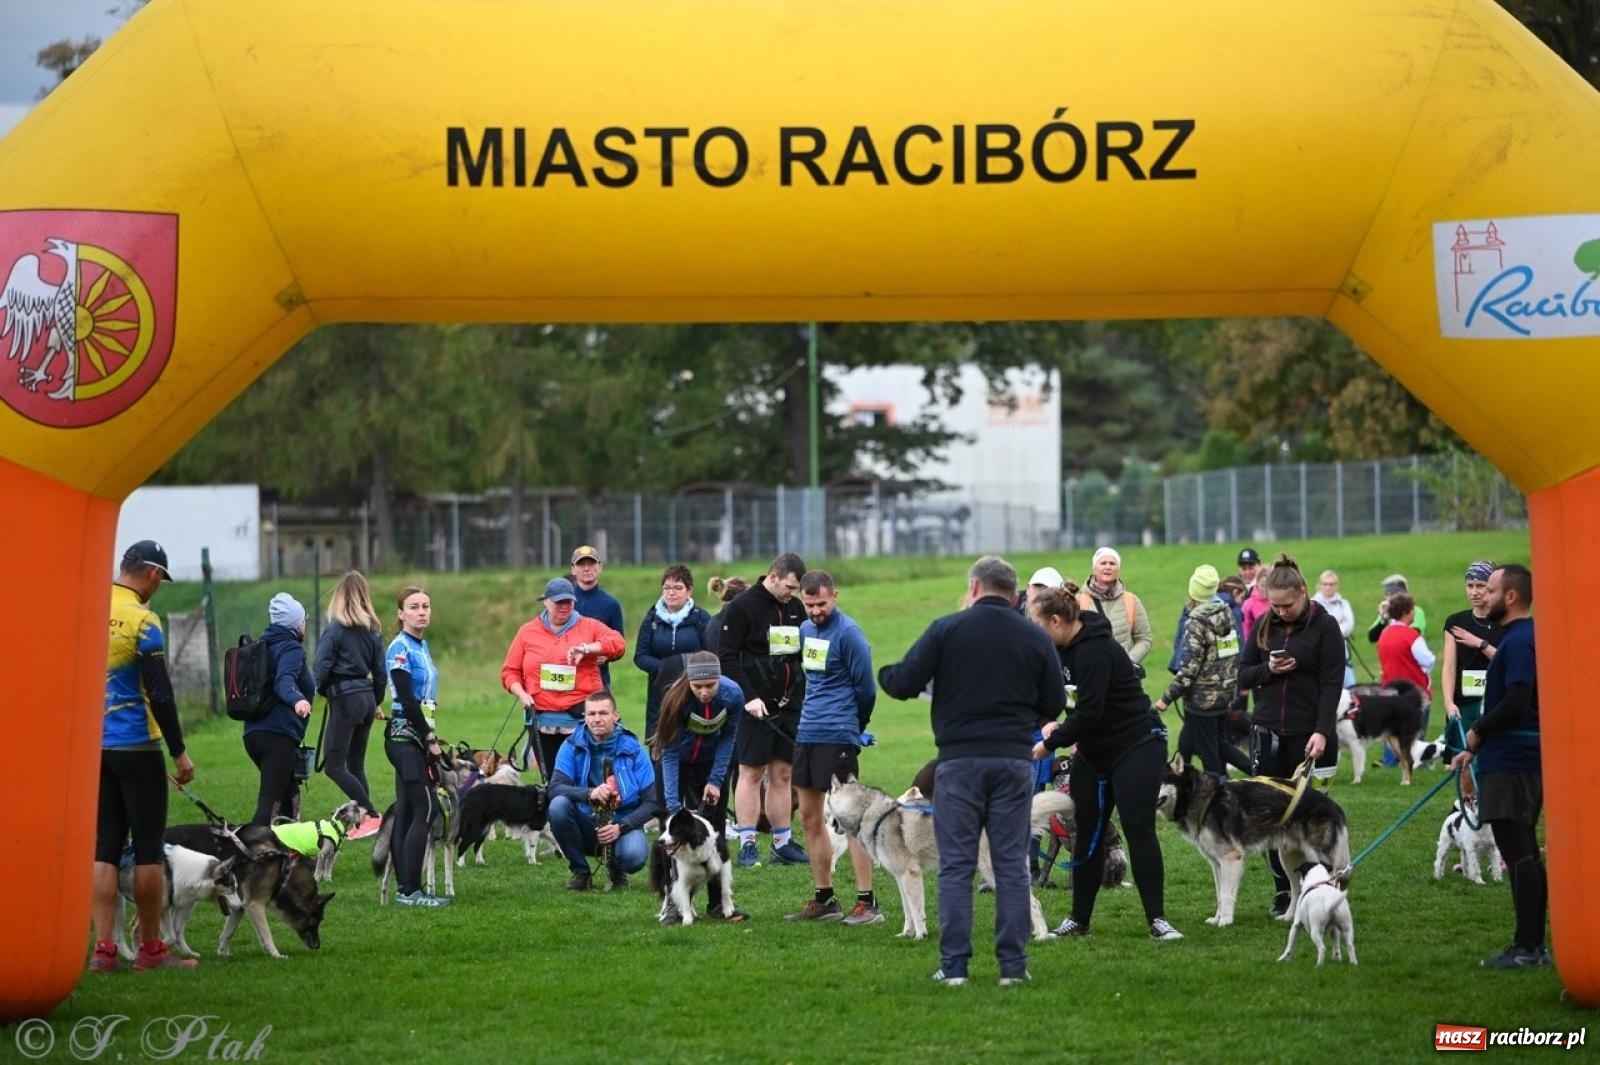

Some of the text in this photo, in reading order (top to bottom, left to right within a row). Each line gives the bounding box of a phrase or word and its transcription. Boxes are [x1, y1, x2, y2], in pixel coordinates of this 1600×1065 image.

[446, 106, 1198, 189] MIASTO RACIBÓRZ
[784, 635, 791, 645] 2
[807, 647, 818, 660] 26
[550, 672, 565, 683] 35
